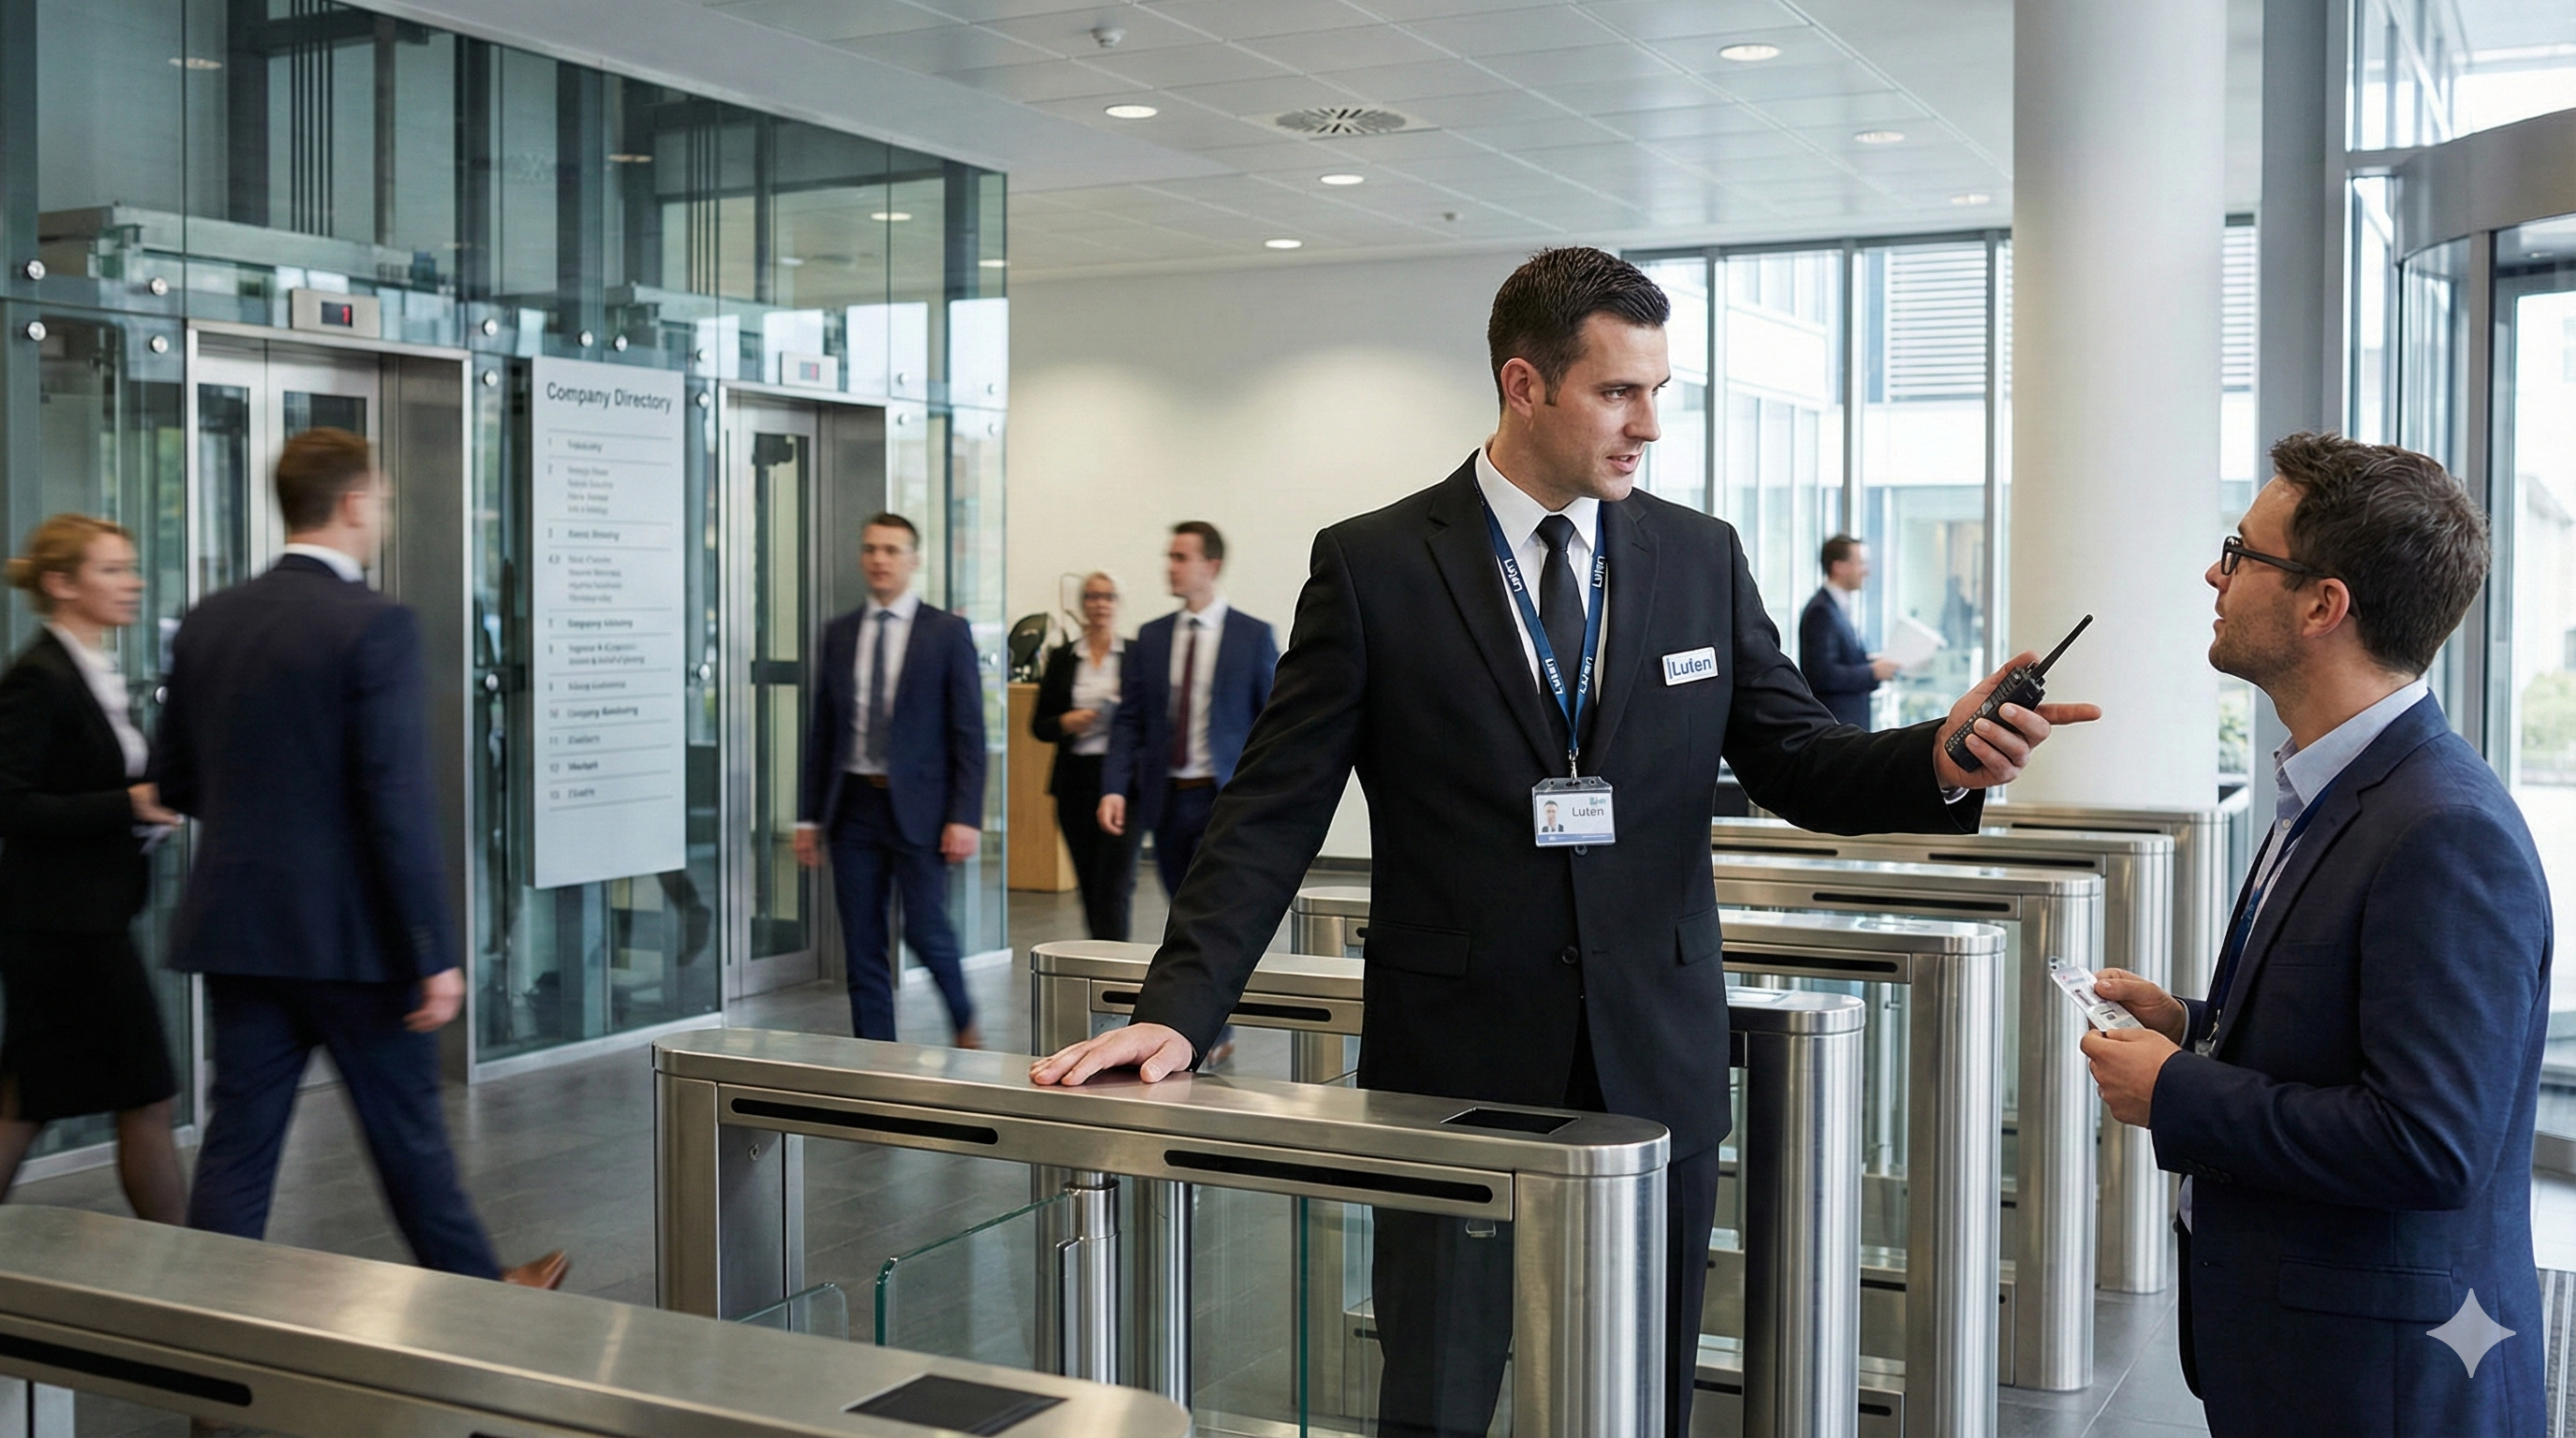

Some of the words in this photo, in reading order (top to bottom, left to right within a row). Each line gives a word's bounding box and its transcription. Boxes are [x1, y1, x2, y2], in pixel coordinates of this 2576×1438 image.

[547, 382, 610, 409] Company
[614, 389, 672, 415] Directory
[1572, 807, 1604, 816] Luten
